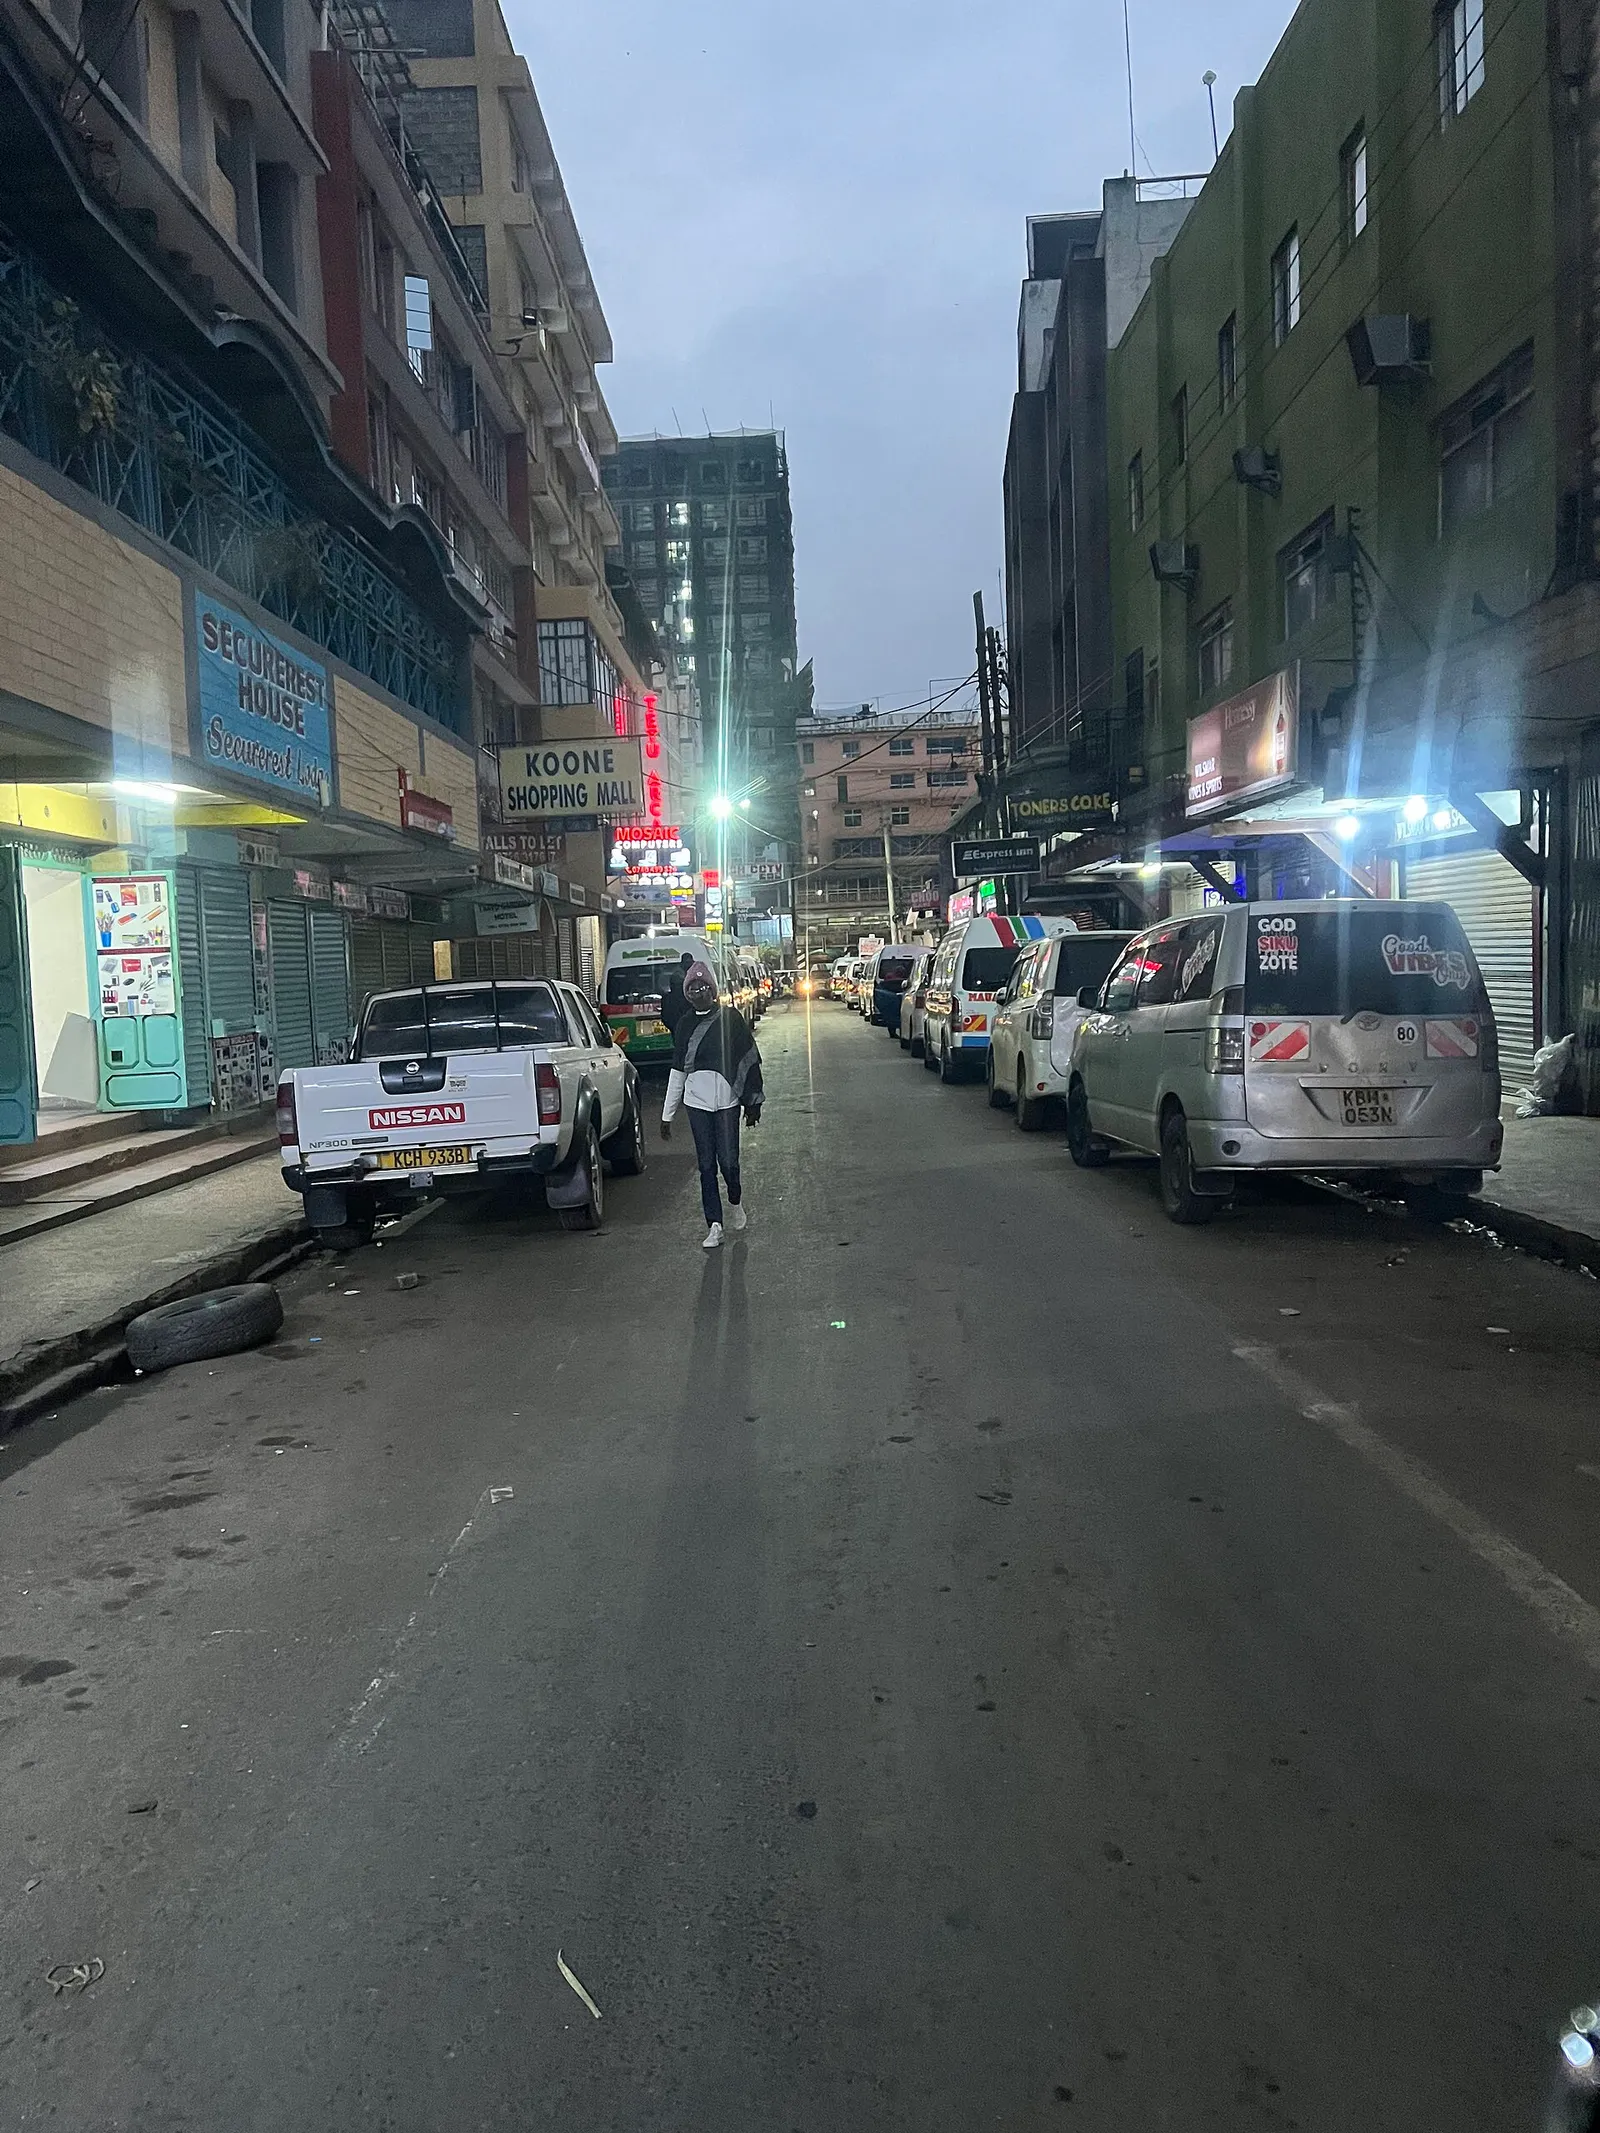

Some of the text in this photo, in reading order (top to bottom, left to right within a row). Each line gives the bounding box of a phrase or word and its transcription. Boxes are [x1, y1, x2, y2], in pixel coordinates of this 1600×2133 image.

[202, 612, 326, 711] SECUREREST
[238, 670, 305, 739] HOUSE
[207, 714, 292, 780] Securerest
[526, 748, 614, 777] KOONE
[507, 783, 588, 811] SHOPPING
[597, 780, 637, 806] MALL
[1010, 798, 1069, 821] TONERS
[520, 836, 536, 850] TO
[540, 835, 562, 850] LET
[614, 826, 680, 841] MOSAIC
[614, 839, 684, 849] COMPUTERS
[973, 848, 1013, 860] Express
[1258, 917, 1296, 932] GOD
[1257, 935, 1298, 952] SIKU
[1382, 935, 1430, 957] Good
[1259, 955, 1298, 970] ZOTE
[1396, 1026, 1415, 1041] 80
[373, 1106, 461, 1127] NISSAN
[309, 1139, 348, 1149] NP300
[393, 1149, 464, 1168] KCH 933B
